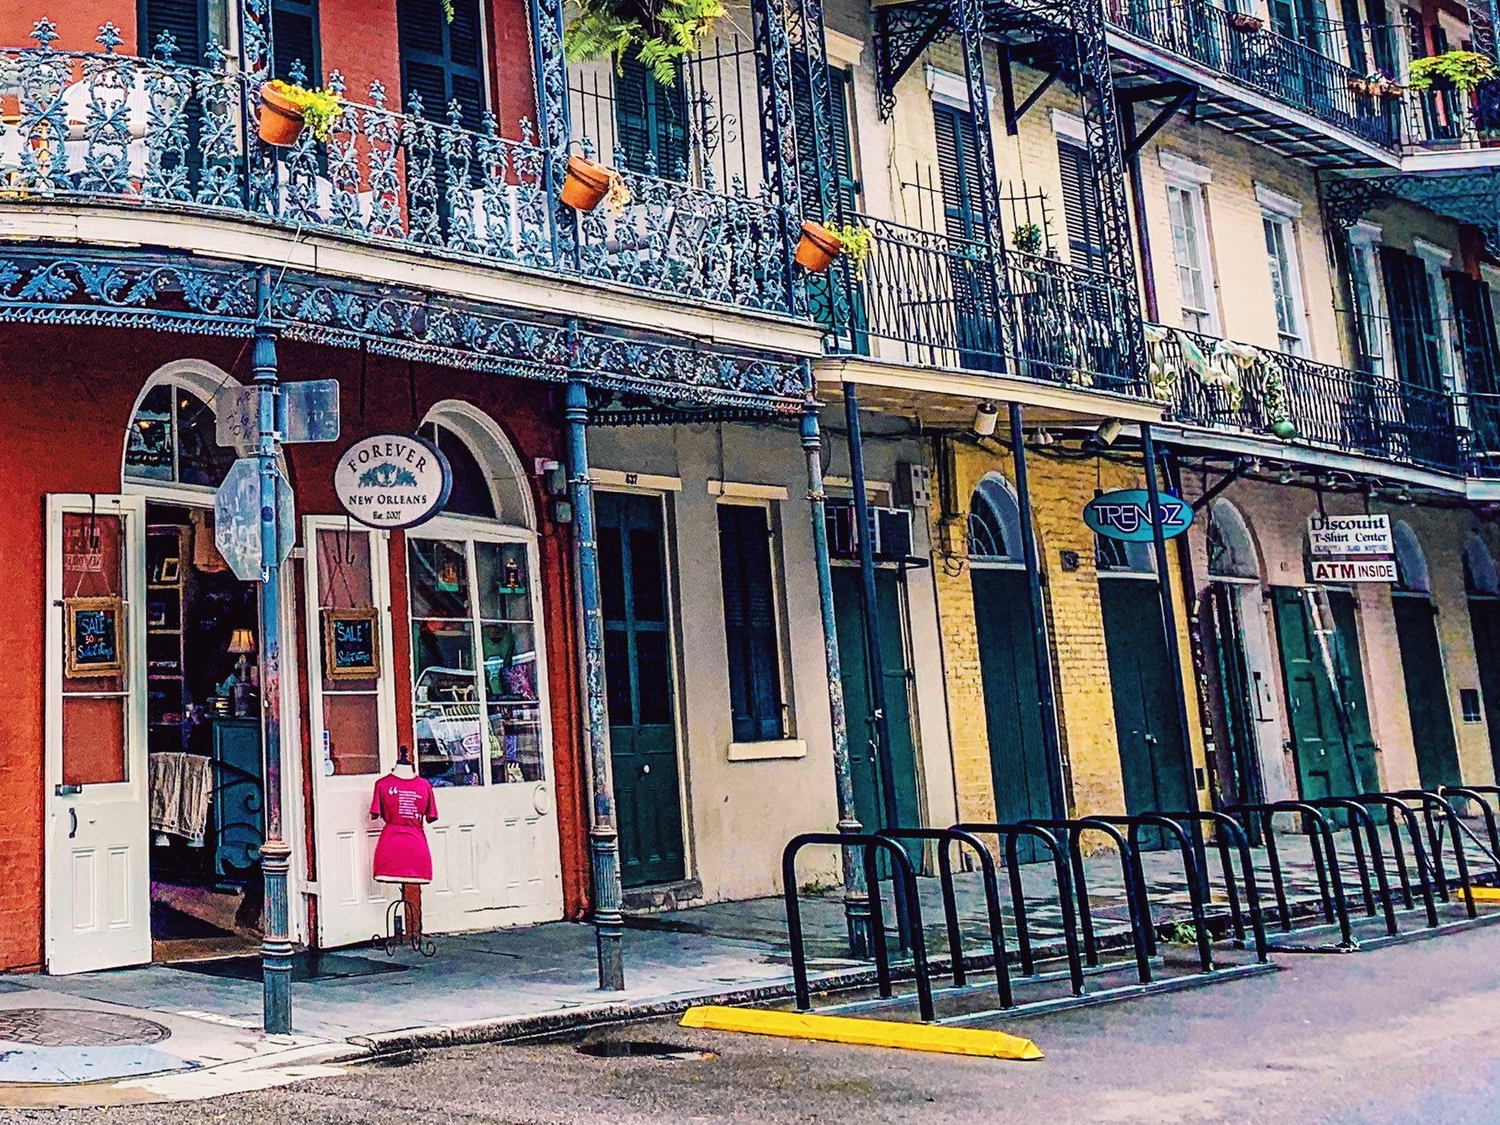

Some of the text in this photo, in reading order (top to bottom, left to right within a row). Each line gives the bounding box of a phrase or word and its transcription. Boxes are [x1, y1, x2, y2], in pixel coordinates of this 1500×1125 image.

[348, 443, 427, 473] FOREVER
[349, 494, 427, 505] NEW ORLEANS
[1311, 517, 1385, 531] Discount
[1315, 532, 1387, 543] T-Shirt Center
[1315, 564, 1394, 579] ATM INSIDE
[81, 616, 106, 635] SALE
[337, 624, 363, 642] SALE
